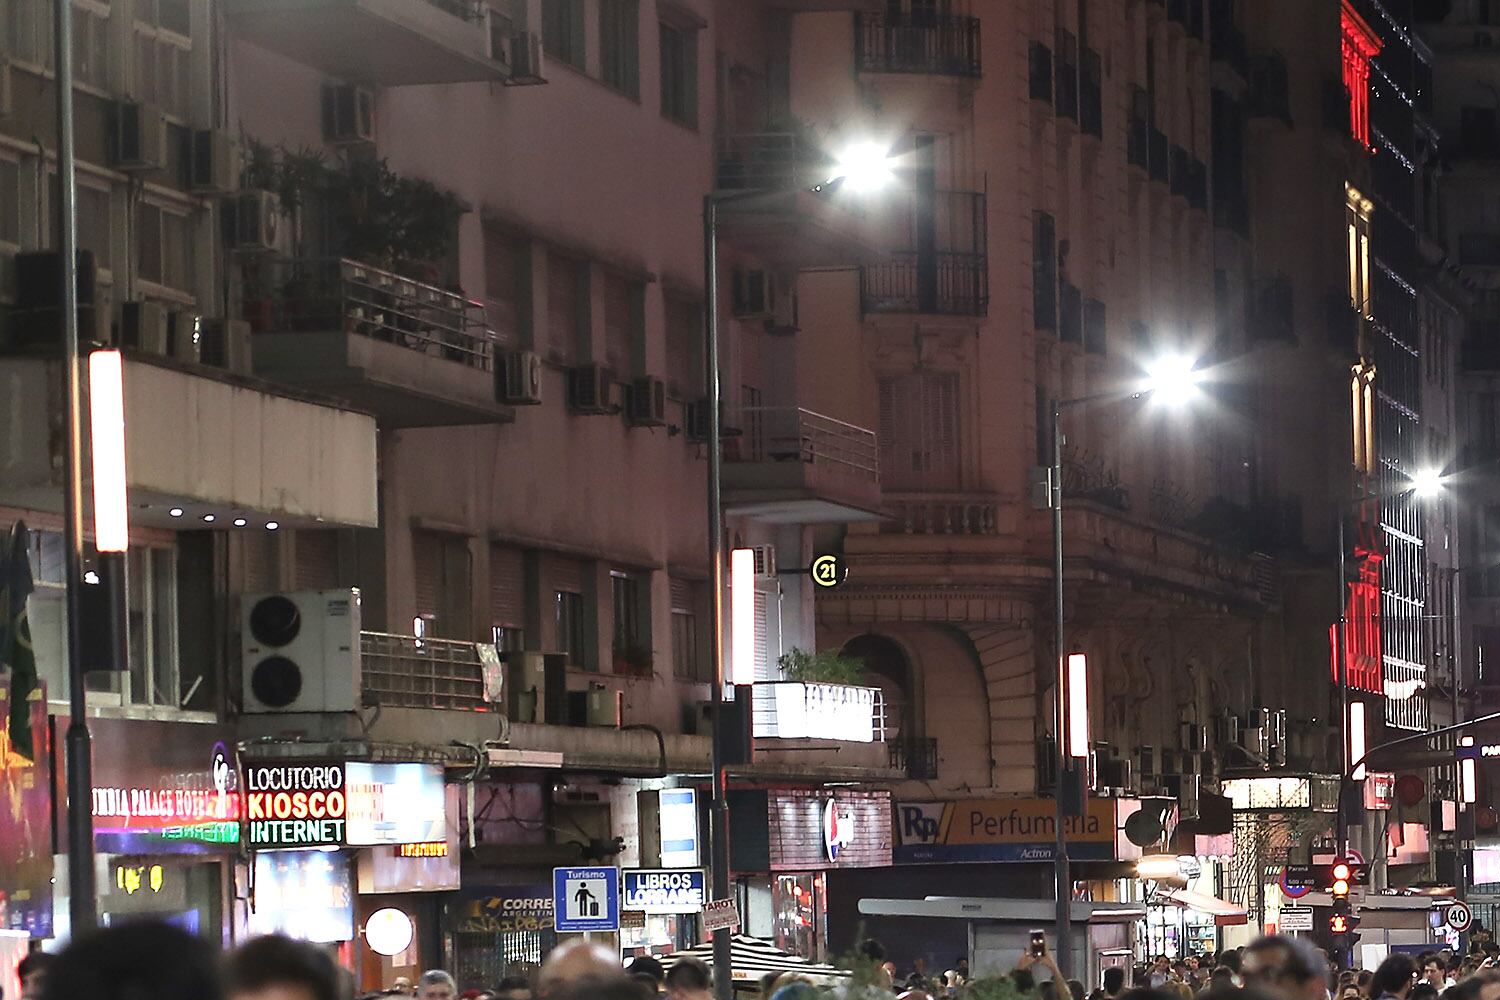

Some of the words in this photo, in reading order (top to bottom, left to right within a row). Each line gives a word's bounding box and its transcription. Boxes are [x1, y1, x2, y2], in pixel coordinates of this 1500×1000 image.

[248, 766, 343, 791] LOCUTORIO
[248, 791, 346, 819] KIOSCO
[250, 819, 345, 844] INTERNET
[1020, 849, 1052, 859] Actron
[567, 870, 606, 880] Turismo
[636, 873, 693, 890] LIBROS
[702, 899, 735, 912] TAROT
[1449, 909, 1467, 924] 40
